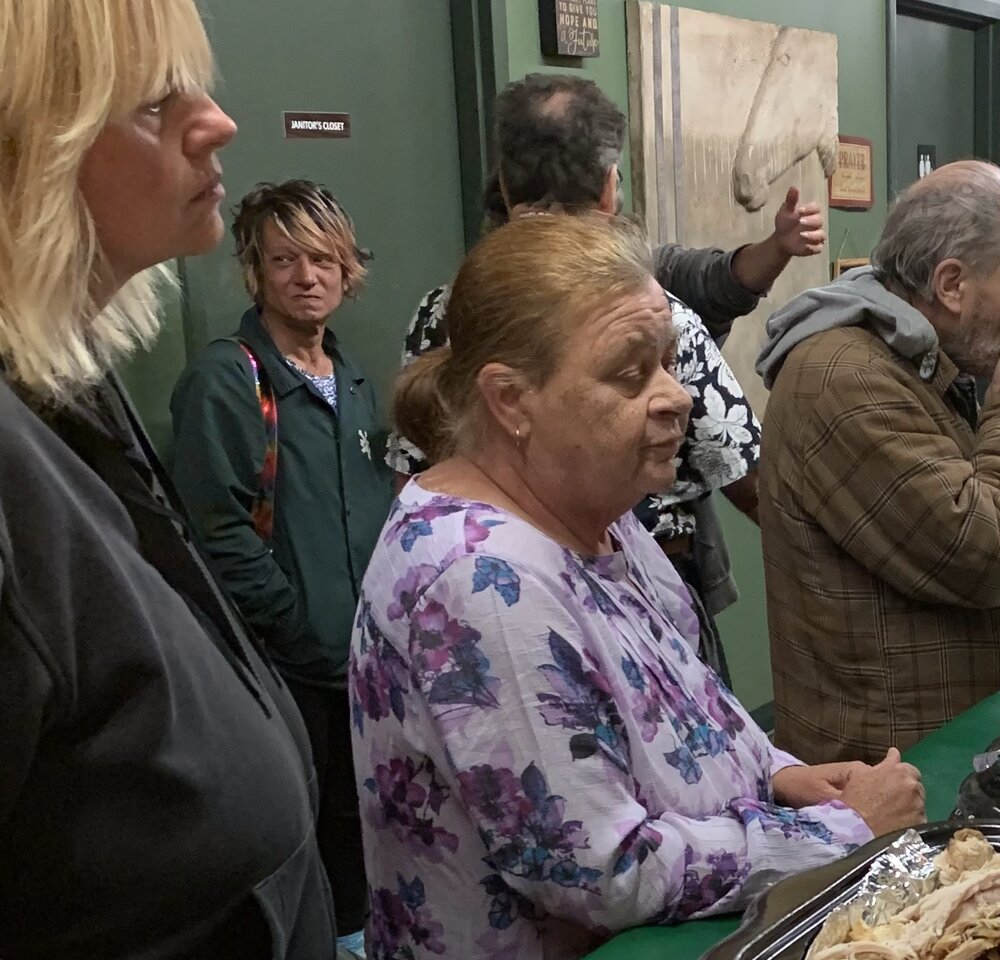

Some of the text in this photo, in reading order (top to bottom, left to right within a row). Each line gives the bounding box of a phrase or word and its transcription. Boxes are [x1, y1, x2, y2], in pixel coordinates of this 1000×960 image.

[559, 2, 567, 12] TO
[559, 13, 598, 30] HOPE AND
[291, 120, 345, 131] JANITOR'S CLOSET
[838, 151, 867, 171] PRAYER
